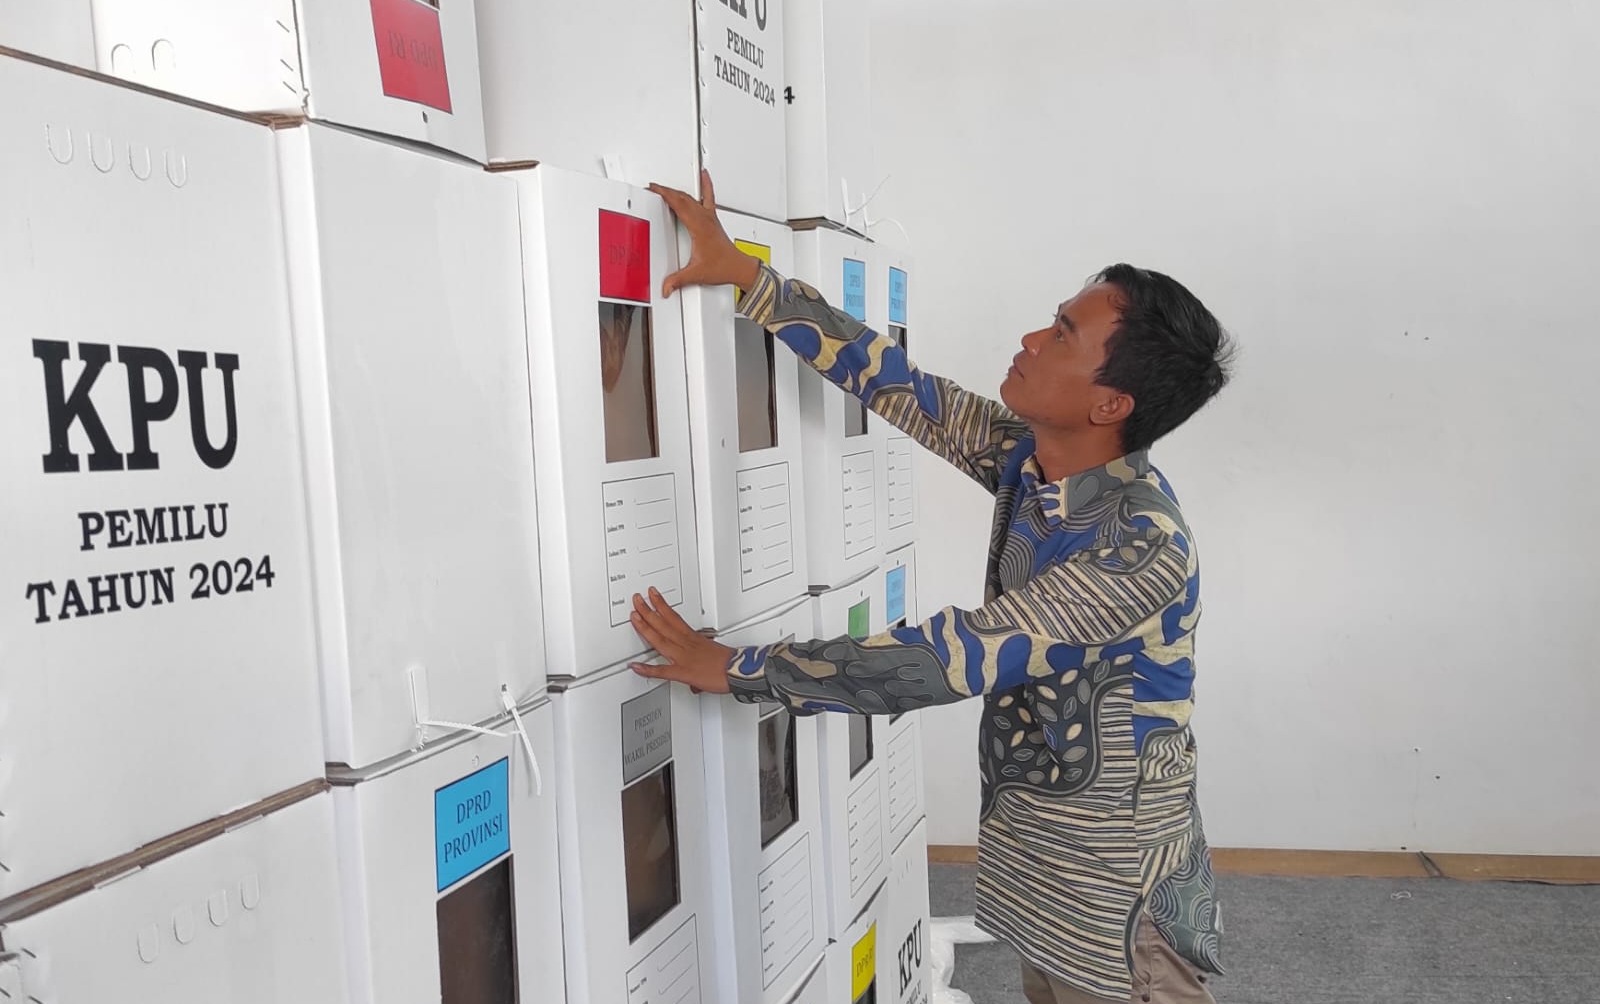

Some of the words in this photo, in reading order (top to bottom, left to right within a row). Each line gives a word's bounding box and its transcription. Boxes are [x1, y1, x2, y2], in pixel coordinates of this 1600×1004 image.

[726, 27, 764, 69] PEMILU
[714, 54, 751, 94] TAHUN
[752, 77, 776, 107] 2024
[32, 338, 240, 473] KPU
[78, 502, 229, 551] PEMILU
[25, 566, 175, 624] TAHUN
[188, 554, 275, 600] 2024
[456, 789, 492, 825] DPRD
[443, 812, 503, 864] PROVINSI
[898, 917, 922, 999] KPU
